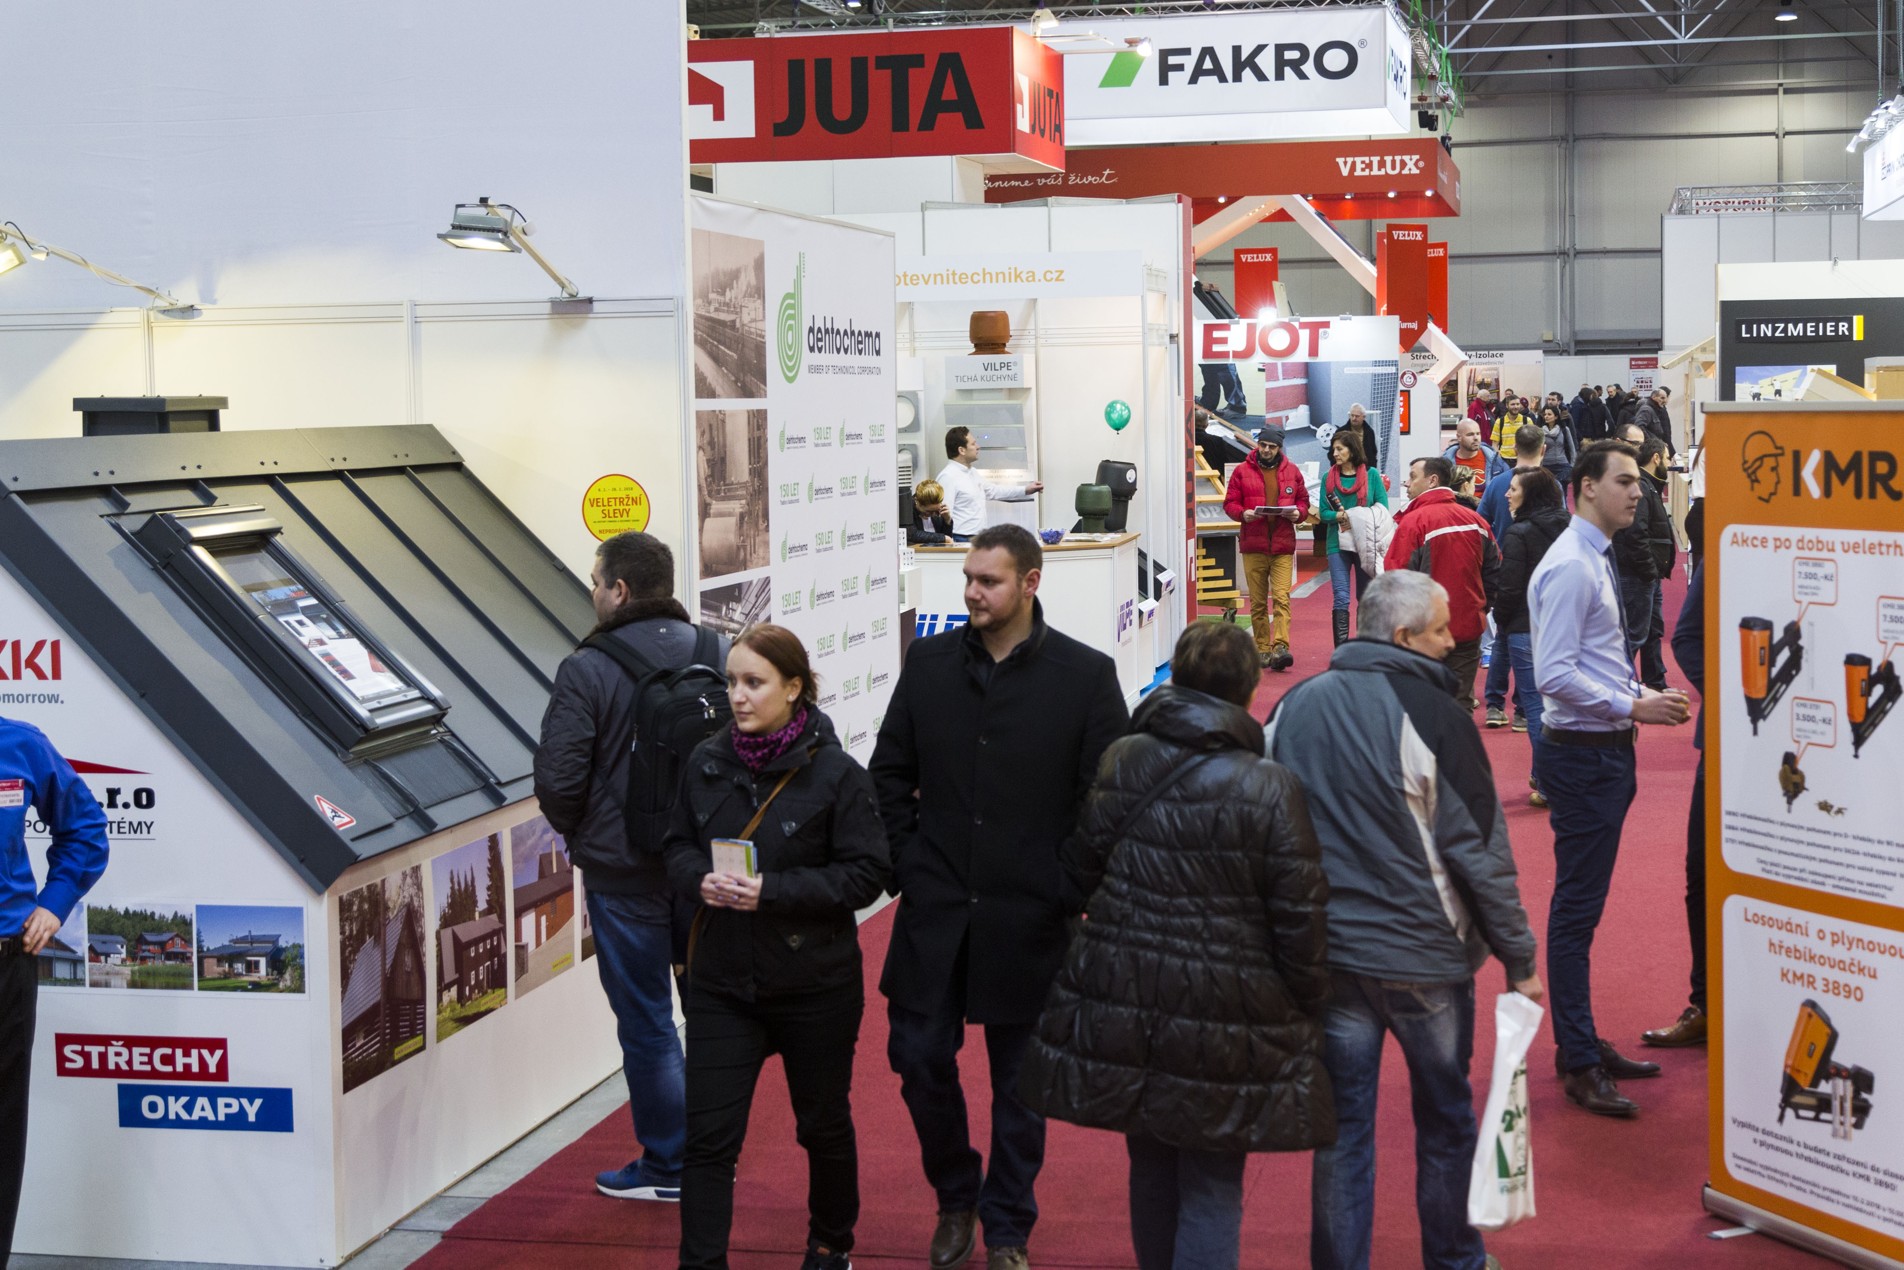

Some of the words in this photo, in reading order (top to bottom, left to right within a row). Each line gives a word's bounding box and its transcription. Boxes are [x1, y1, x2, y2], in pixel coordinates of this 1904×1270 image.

[1158, 40, 1359, 86] FAKRO
[773, 52, 985, 137] JUTA
[1031, 80, 1062, 146] JUTA
[1336, 155, 1420, 177] VELUX
[1392, 230, 1422, 240] VELUX
[1240, 253, 1272, 262] VELUX
[1427, 248, 1445, 257] ELUX
[808, 314, 881, 357] dehtochema
[1202, 321, 1331, 359] EJOT
[1741, 322, 1849, 337] LINZMEIER
[983, 361, 1012, 372] VILPE
[1410, 352, 1439, 361] Střech
[955, 373, 978, 383] TICHÁ
[1792, 449, 1904, 501] KMR
[589, 493, 643, 507] VELETRŽNÍ
[601, 508, 631, 519] SLEVY
[1730, 532, 1768, 548] Akce
[1773, 535, 1792, 553] po
[1796, 536, 1836, 553] dobu
[108, 817, 154, 835] TÉMY
[1744, 907, 1809, 938] Losování
[1816, 928, 1826, 941] o
[1780, 967, 1818, 991] KMR
[1821, 977, 1864, 1002] 3890
[63, 1040, 224, 1073] STŘECHY
[141, 1093, 263, 1123] OKAPY
